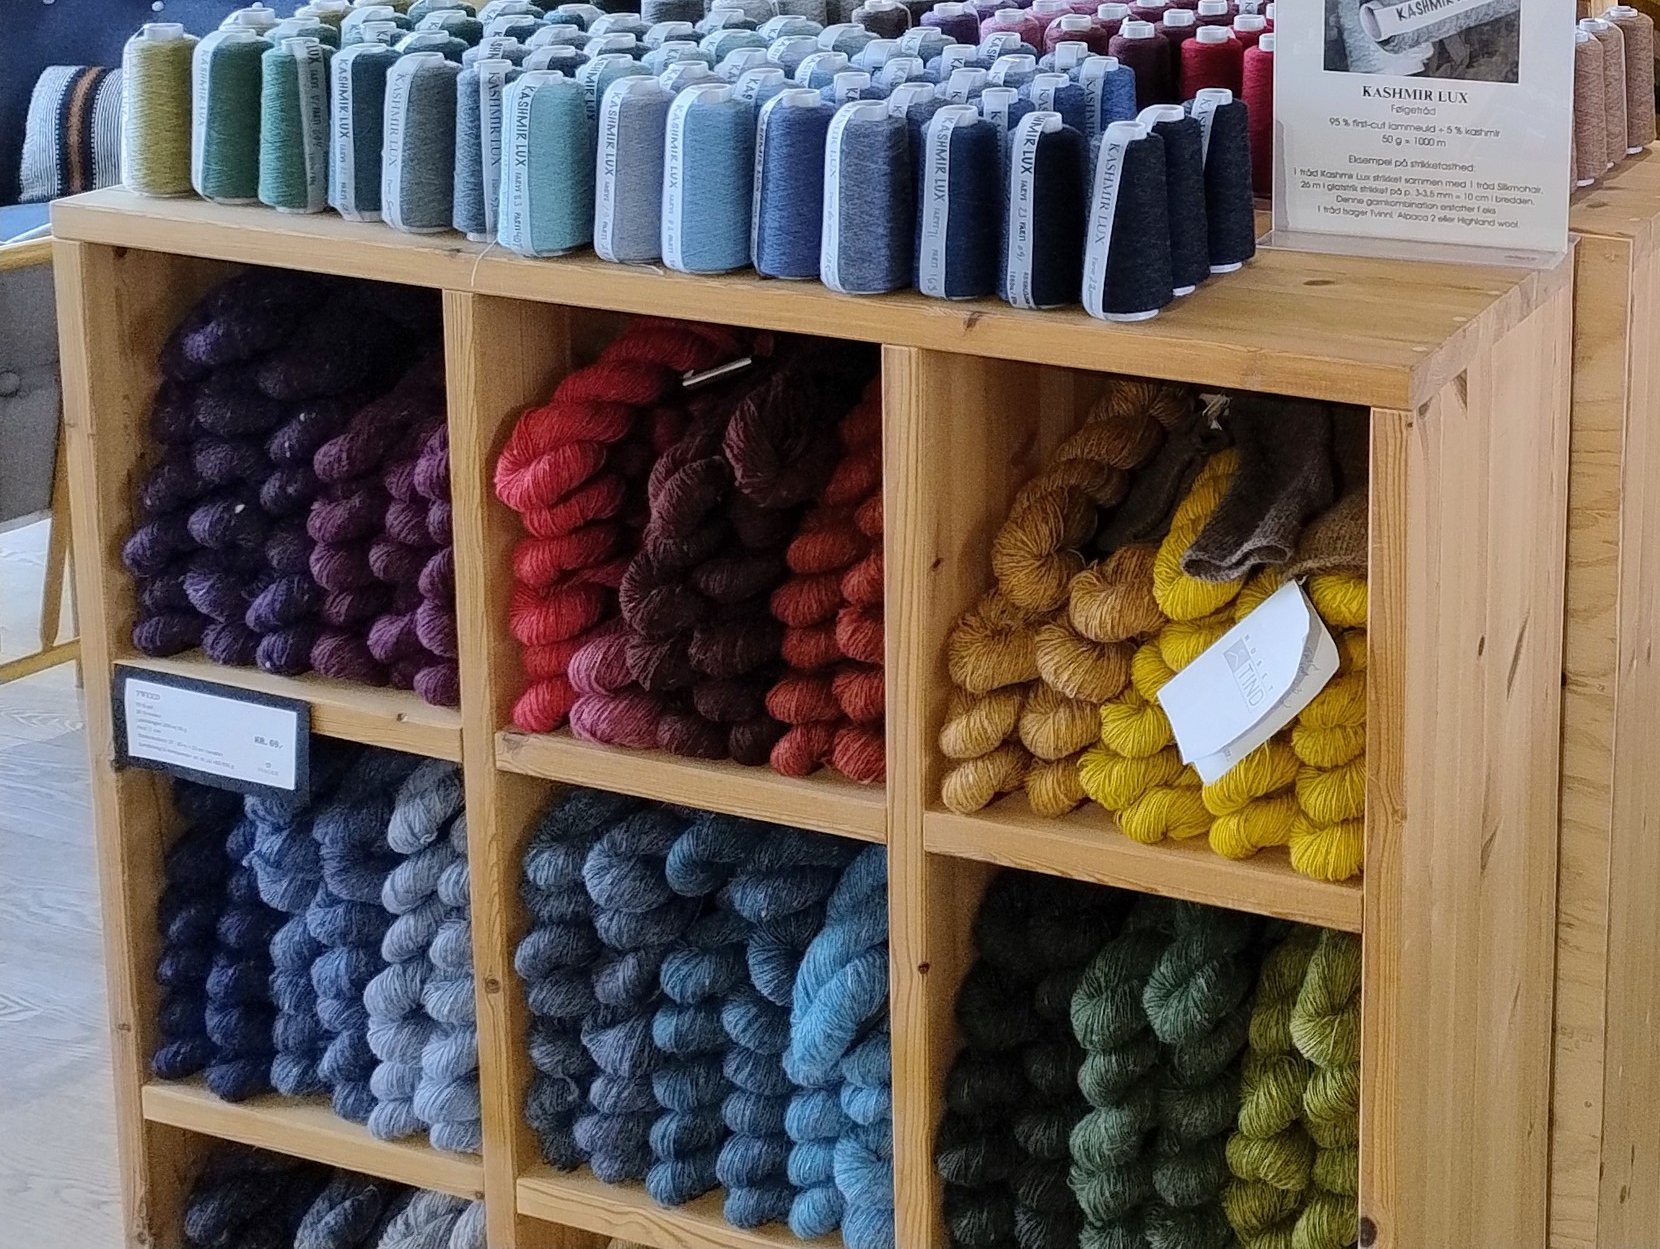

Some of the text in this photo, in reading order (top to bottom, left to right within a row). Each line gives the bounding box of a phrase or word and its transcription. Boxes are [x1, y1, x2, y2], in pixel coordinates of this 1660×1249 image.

[306, 45, 321, 65] LUX
[338, 59, 349, 113] KASHMIR
[1362, 85, 1468, 104] KASHMIR LUX
[389, 73, 407, 136] KASHMIR
[488, 72, 502, 134] KASHMIR
[516, 85, 536, 140] KASHMIR
[339, 117, 349, 139] LUX
[605, 92, 621, 149] KASHMIR
[670, 104, 684, 161] KASHMIR
[1024, 116, 1045, 146] HMIR
[1329, 117, 1340, 127] 95
[1342, 118, 1350, 127] %
[1352, 119, 1386, 129] first-cut
[1388, 122, 1436, 133] lammeuld
[1446, 126, 1452, 134] 5
[1454, 126, 1462, 135] %
[1465, 127, 1501, 137] kashmir
[490, 139, 501, 166] LUX
[935, 117, 955, 174] KASHMIR
[1382, 134, 1393, 144] 50
[1395, 137, 1402, 146] g
[1414, 136, 1435, 147] 1000
[388, 140, 401, 167] LUX
[515, 144, 526, 167] LUX
[605, 153, 615, 176] LUX
[1021, 150, 1034, 174] LUX
[1348, 155, 1393, 166] Eksempel
[1394, 158, 1408, 168] på
[669, 166, 678, 189] LUX
[1099, 143, 1121, 210] KASHMIR
[1356, 172, 1371, 180] Lux
[1404, 177, 1443, 186] sammen
[1445, 180, 1466, 189] med
[934, 178, 946, 202] LUX
[1436, 192, 1453, 200] mm
[1464, 193, 1474, 201] 10
[1475, 194, 1489, 202] cm
[1397, 211, 1429, 222] Alpaca
[1094, 216, 1108, 246] LUX
[1237, 663, 1265, 707] TIND
